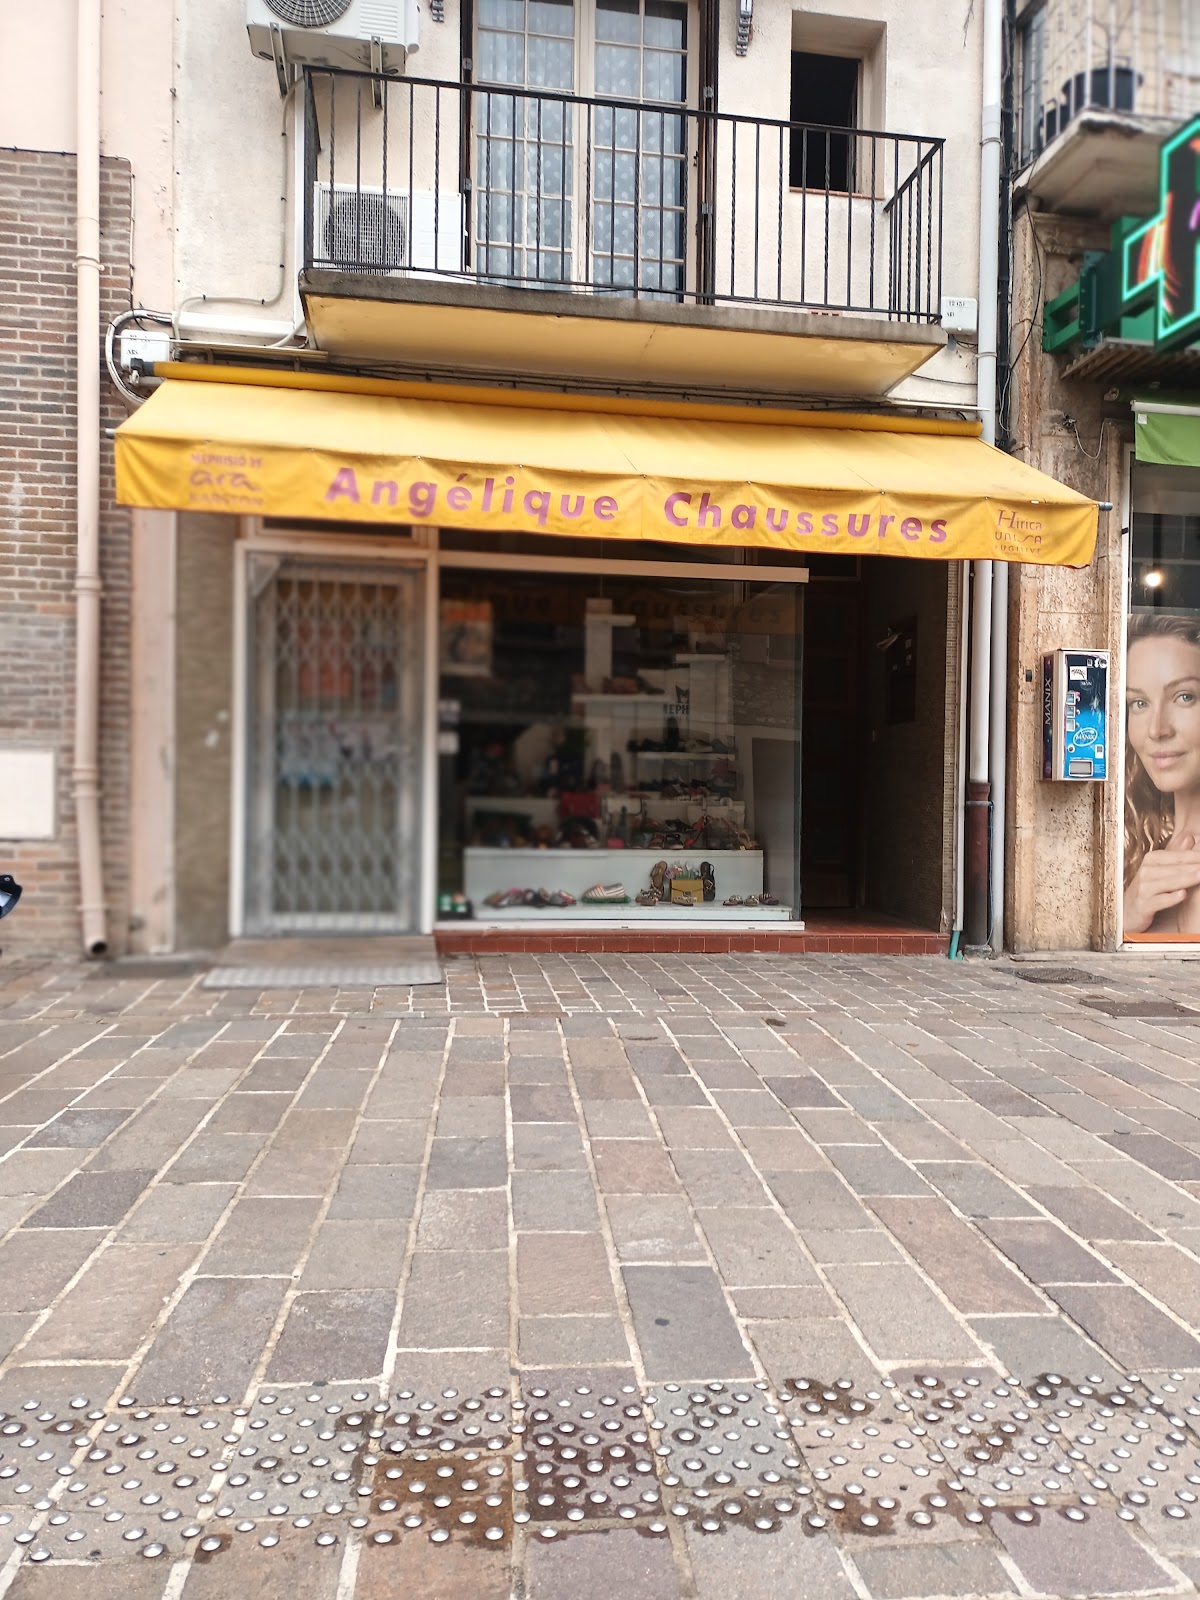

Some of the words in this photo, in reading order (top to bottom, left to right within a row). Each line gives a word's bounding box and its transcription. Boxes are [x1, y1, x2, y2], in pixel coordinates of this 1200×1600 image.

[325, 467, 620, 523] Angélique
[664, 491, 949, 544] Chaussures
[997, 509, 1042, 530] Hirica
[1044, 678, 1052, 725] MANIX
